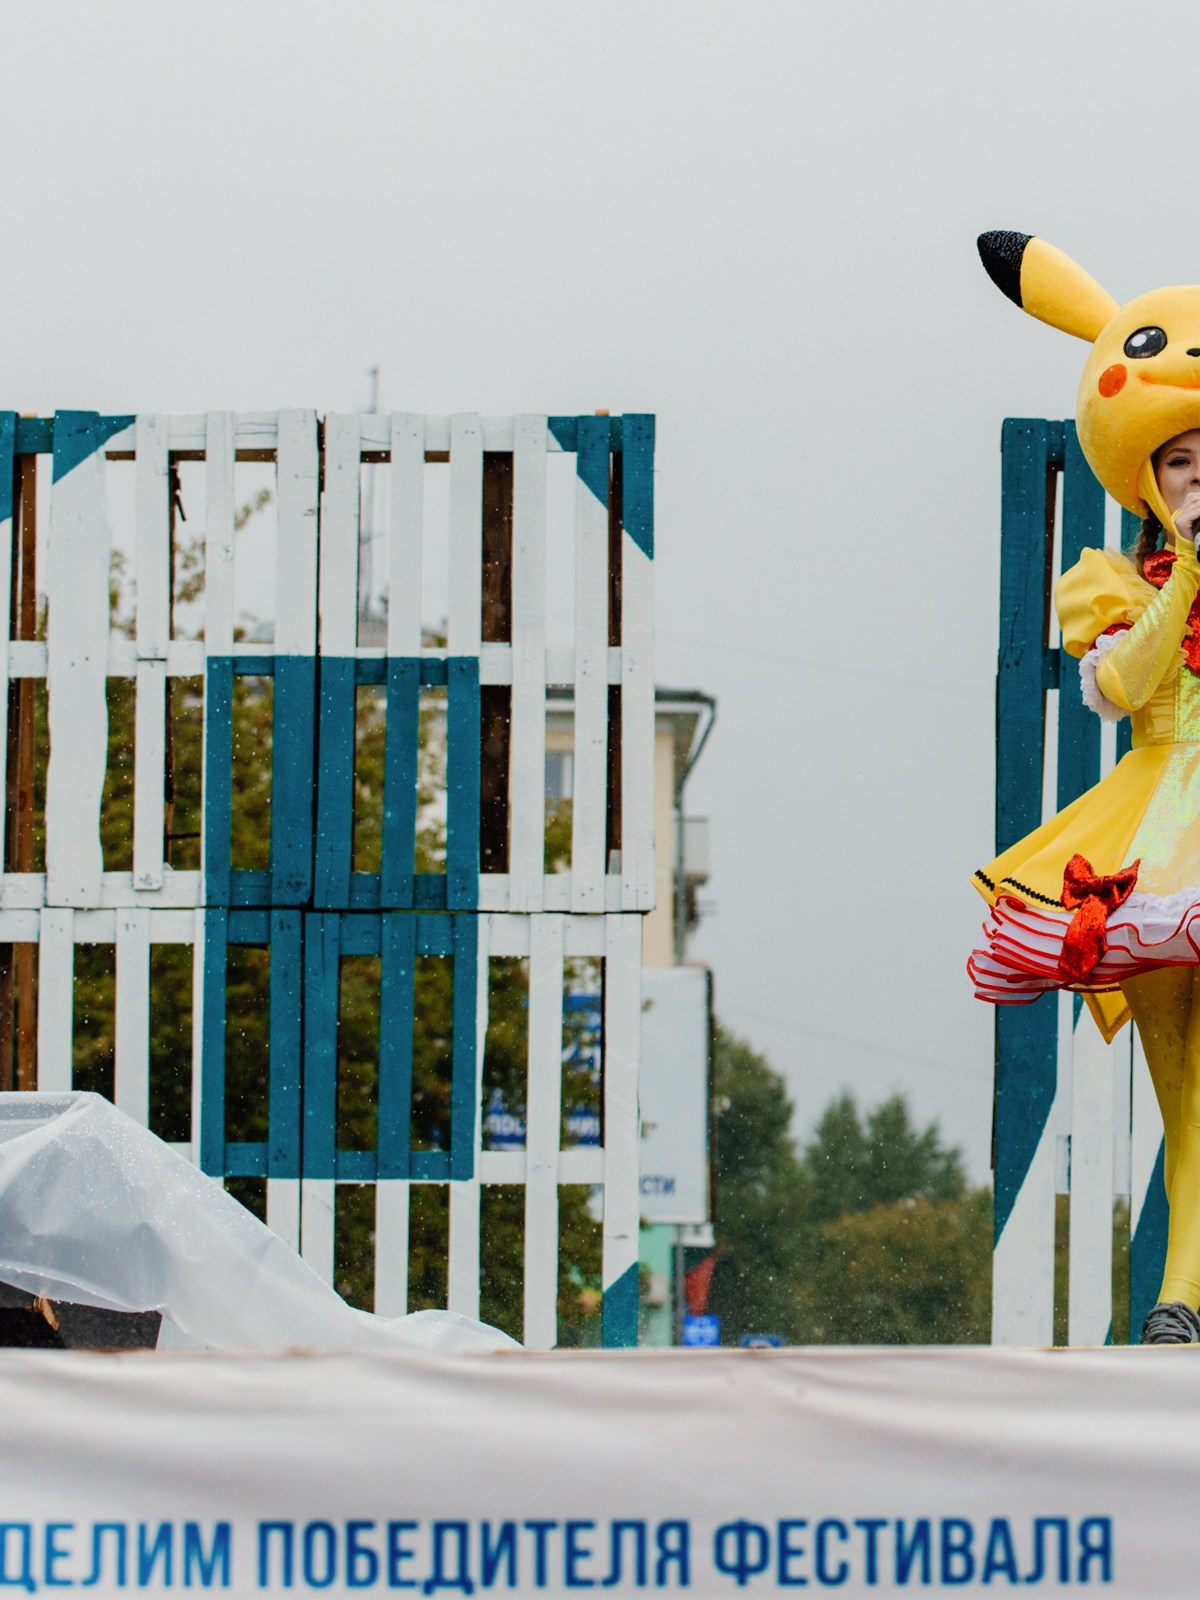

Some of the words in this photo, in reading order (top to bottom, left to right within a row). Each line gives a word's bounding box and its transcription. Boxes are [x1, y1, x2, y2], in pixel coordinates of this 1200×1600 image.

[0, 1520, 232, 1594] ДЕЛИМ
[257, 1519, 690, 1595] ПОБЕДИТЕЛЯ
[713, 1516, 1112, 1587] ФЕСТИВАЛЯ
